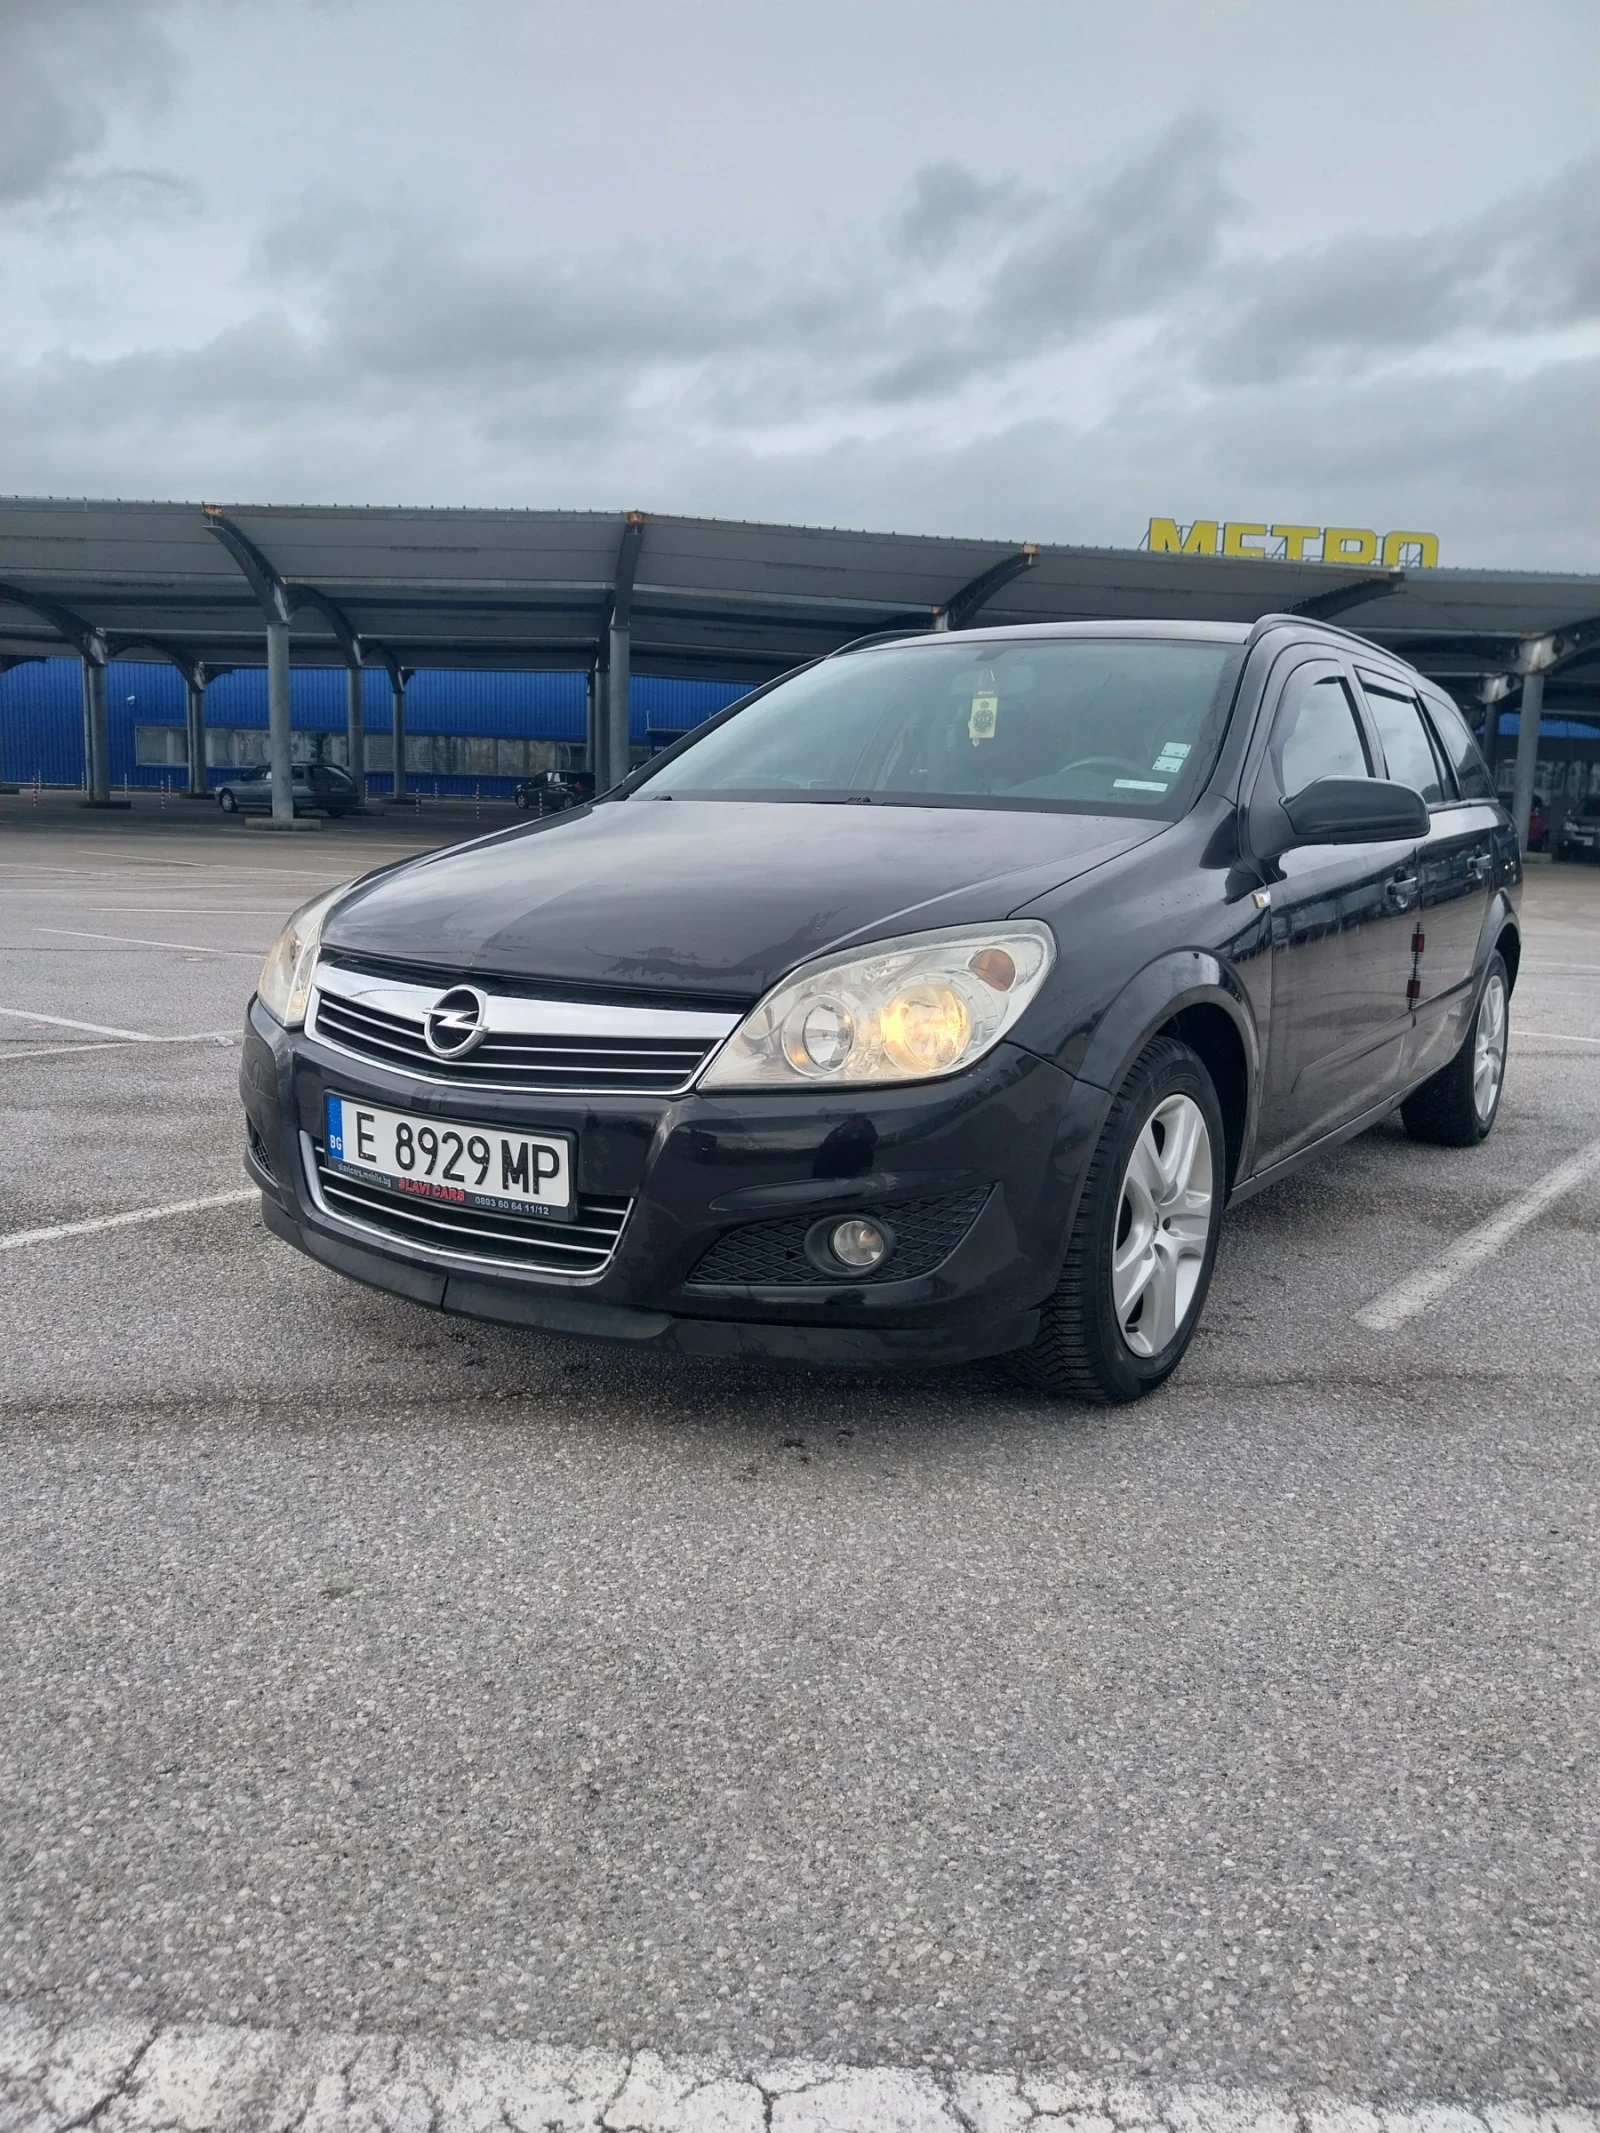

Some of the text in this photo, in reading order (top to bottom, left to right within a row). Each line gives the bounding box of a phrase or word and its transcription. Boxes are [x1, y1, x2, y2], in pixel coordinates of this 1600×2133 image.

[1149, 517, 1439, 568] METRO
[330, 1134, 343, 1151] BG
[356, 1110, 560, 1195] E 8929 MP
[338, 1163, 392, 1188] slavicars.mobile.bg
[398, 1178, 465, 1202] SLAVI CARS
[475, 1196, 549, 1215] 0893 60 64 11/12
